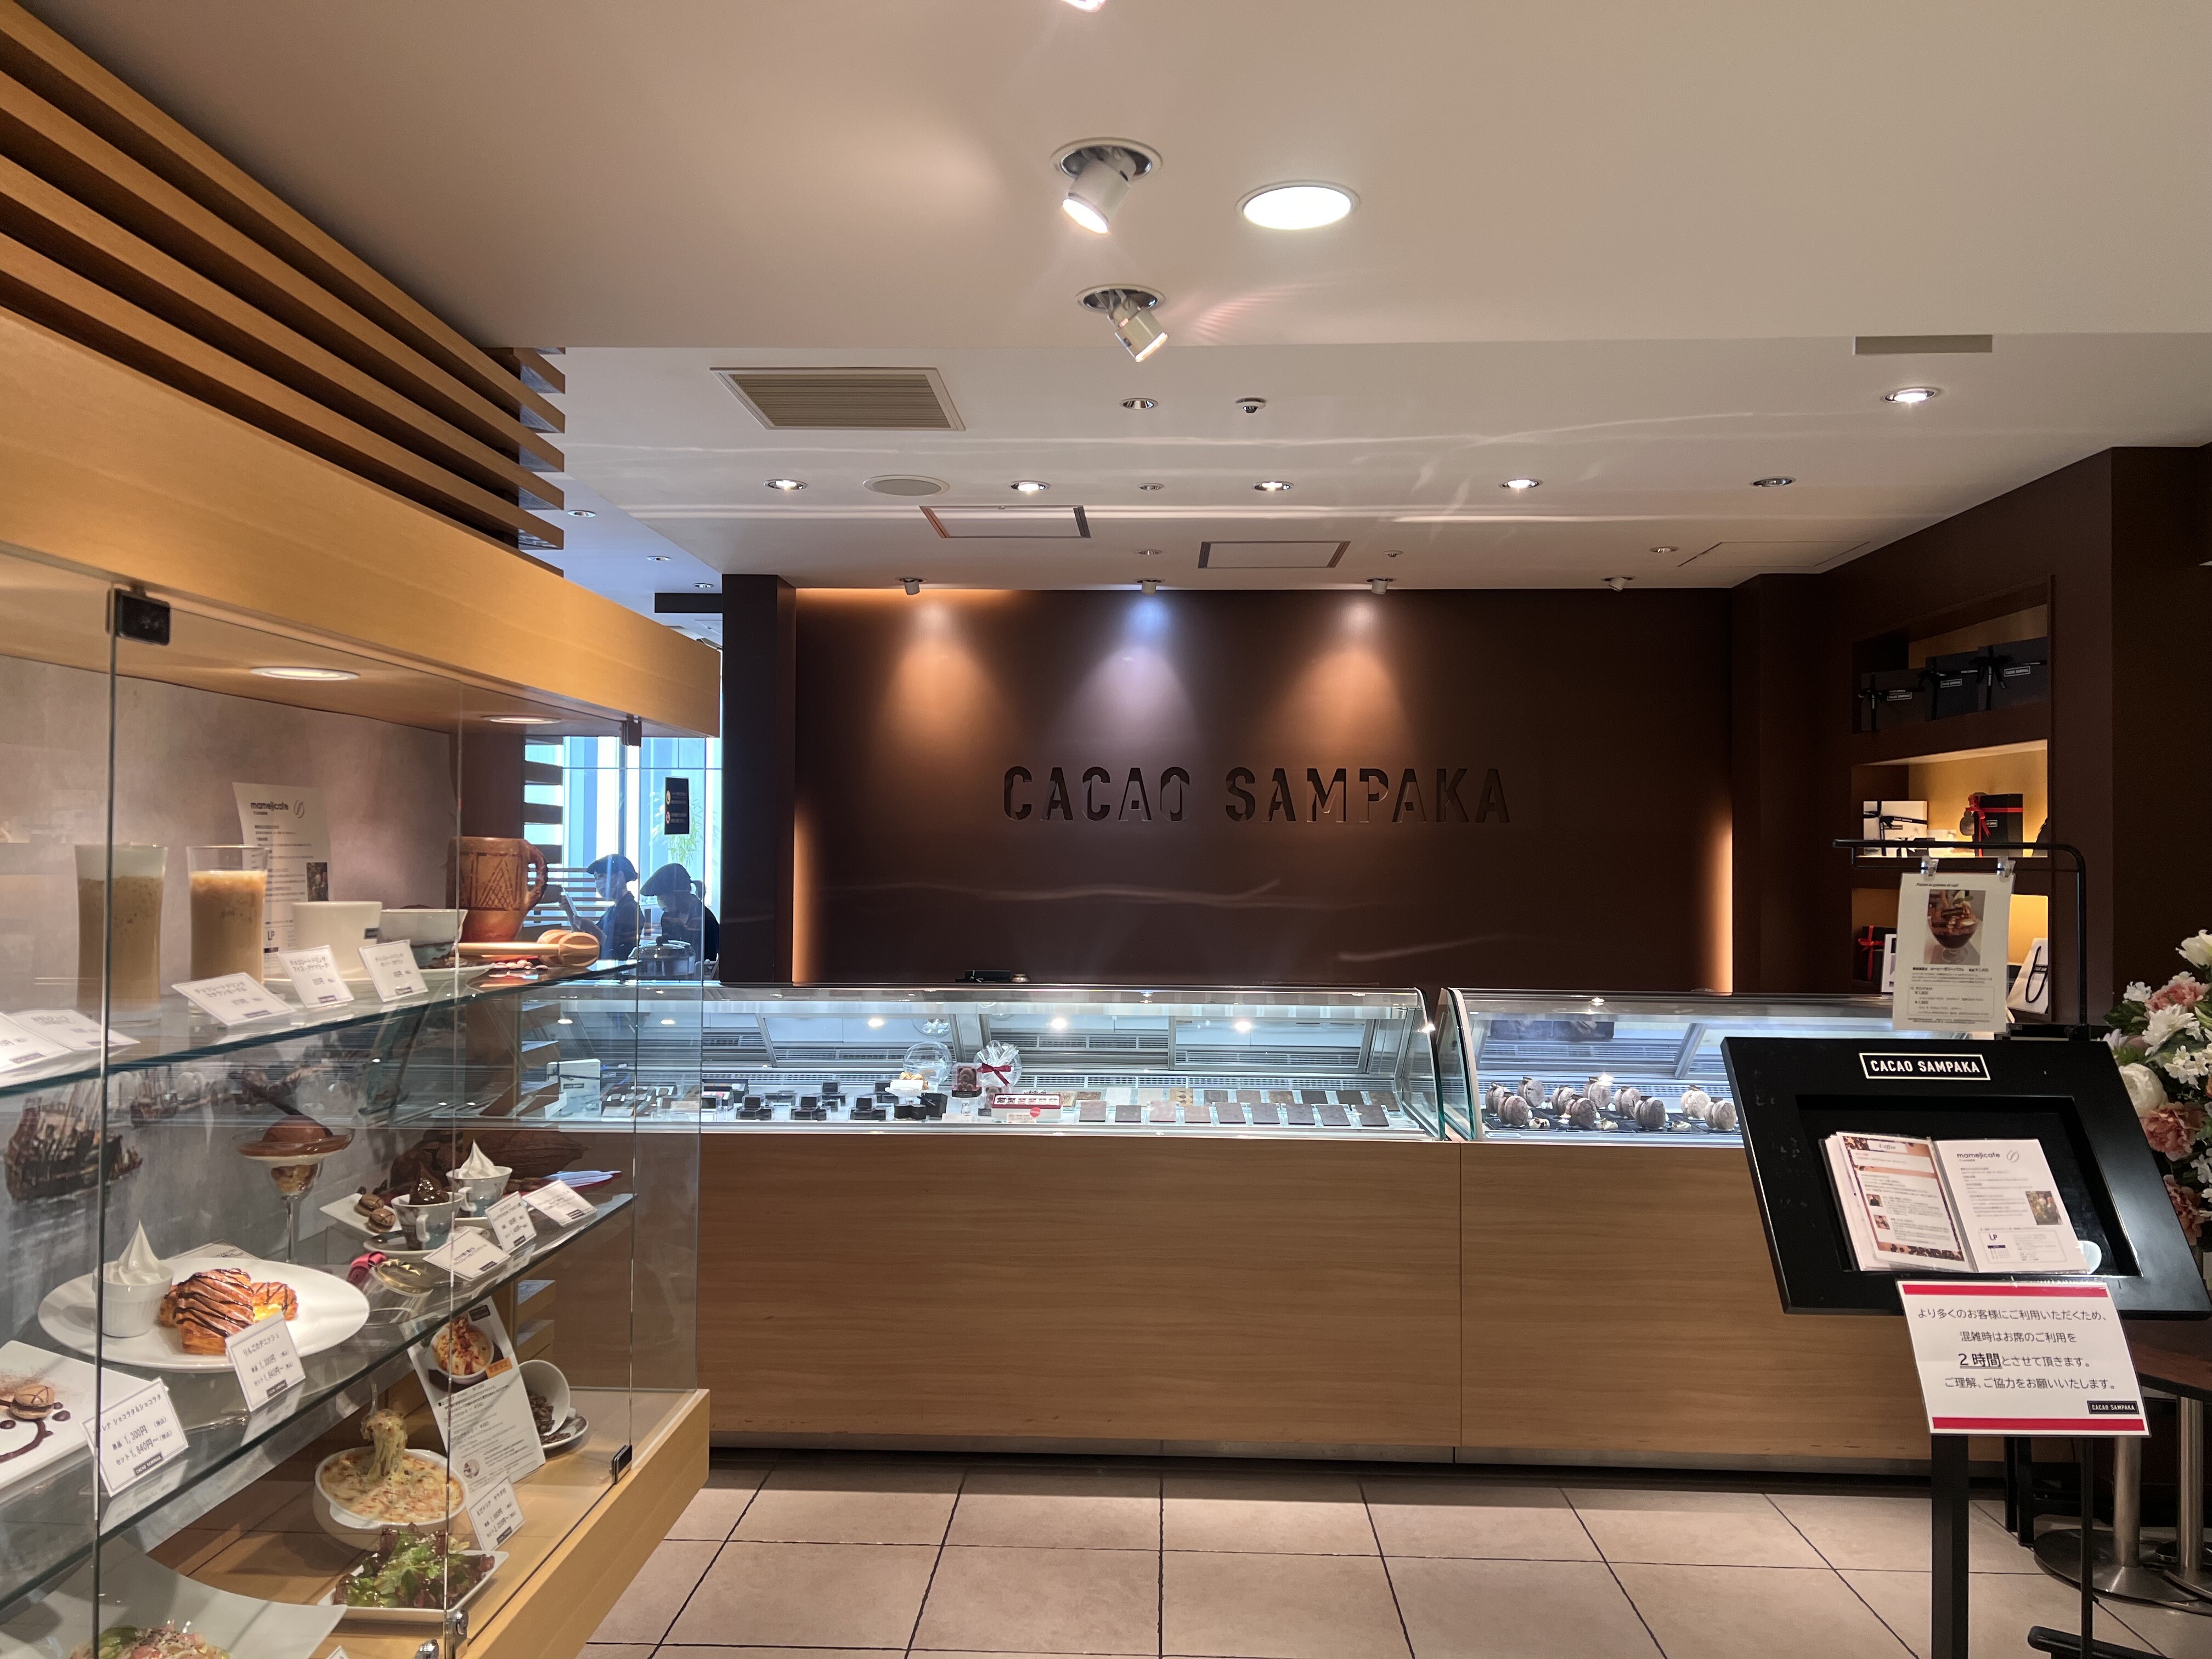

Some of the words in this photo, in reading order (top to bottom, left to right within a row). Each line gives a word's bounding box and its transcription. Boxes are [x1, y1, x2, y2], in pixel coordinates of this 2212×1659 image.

[1003, 766, 1190, 822] CACAO
[1225, 767, 1510, 823] SAMPAKA
[1870, 1060, 1914, 1072] CACAO
[1917, 1061, 1980, 1073] SAMPAKA
[1917, 1308, 2107, 1321] より多くのお客様にご利用いただくため、
[1959, 1331, 2077, 1344] 混雑時はお席のご利用を
[1944, 1376, 2115, 1390] ご理解、ご協力をお願いいたします。
